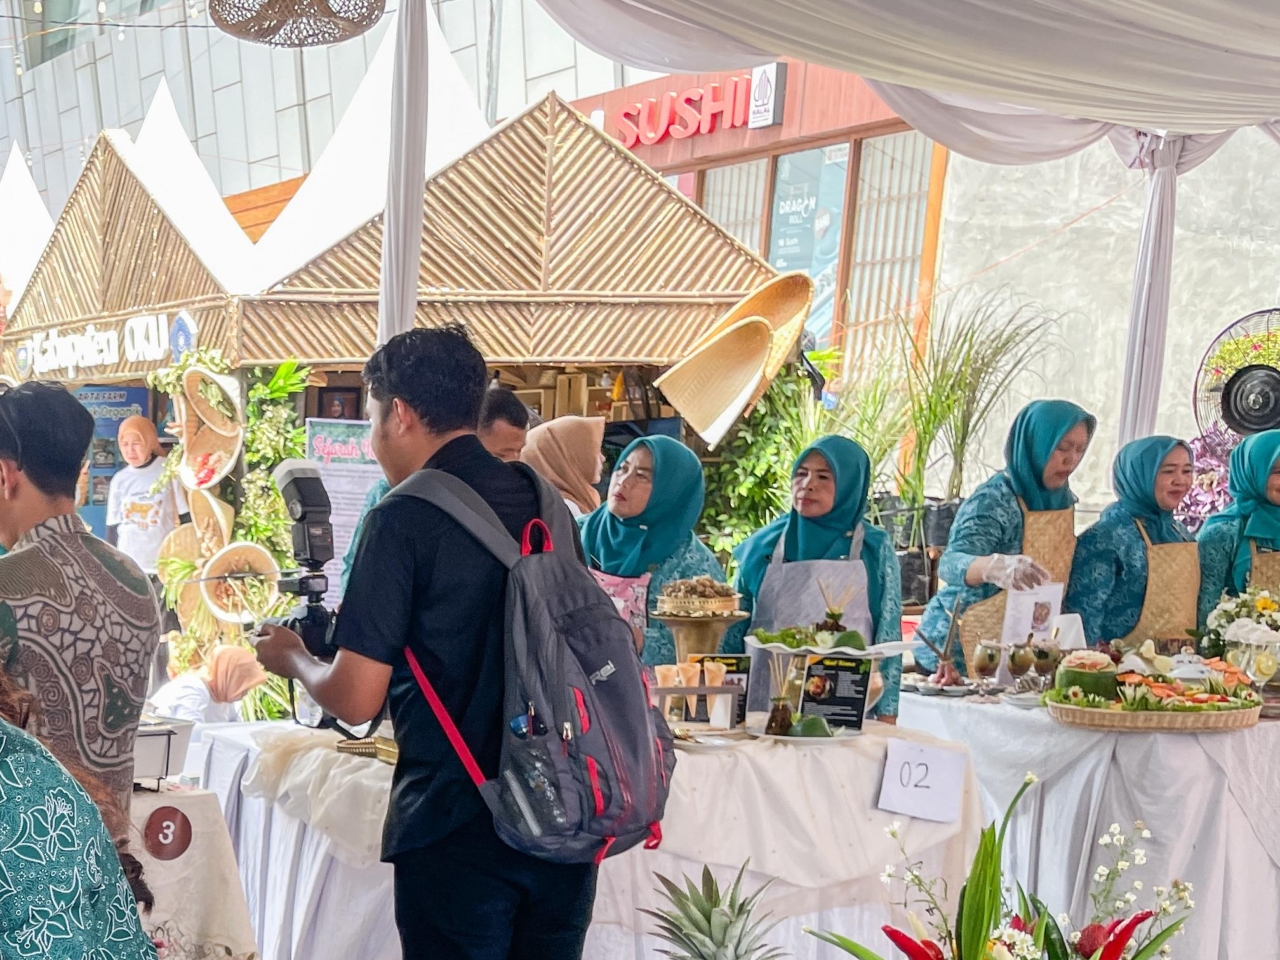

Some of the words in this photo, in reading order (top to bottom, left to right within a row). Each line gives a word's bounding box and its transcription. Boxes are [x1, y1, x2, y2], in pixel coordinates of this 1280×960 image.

[614, 75, 751, 149] SUSHI
[779, 196, 816, 217] DRAGON
[28, 325, 119, 379] Kabupaten
[124, 314, 170, 363] OKU
[101, 404, 141, 419] Organik
[313, 435, 361, 466] Sejarah
[899, 761, 930, 788] 02
[158, 820, 175, 845] 3
